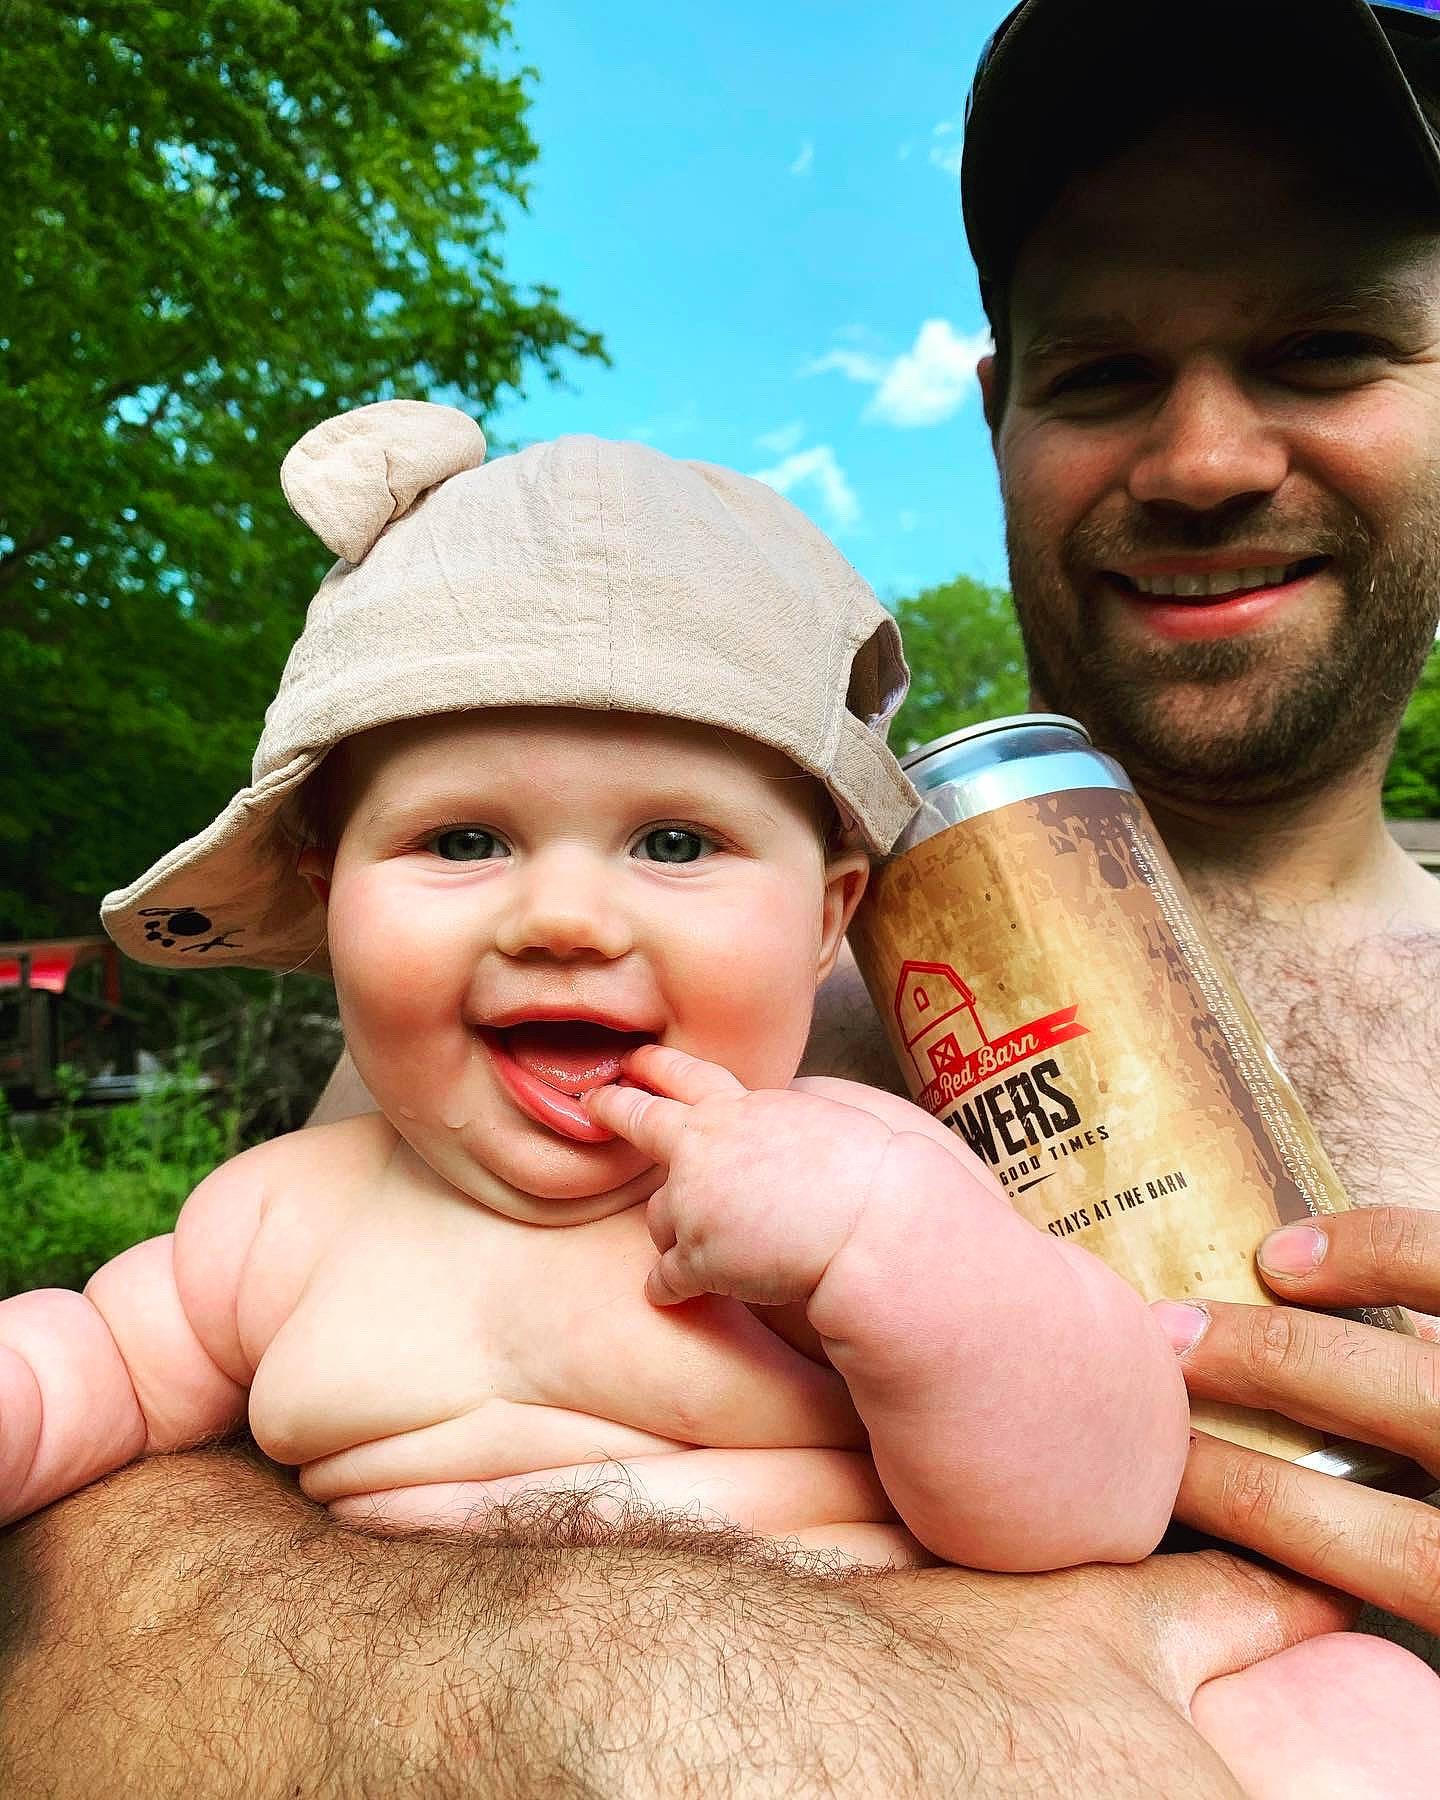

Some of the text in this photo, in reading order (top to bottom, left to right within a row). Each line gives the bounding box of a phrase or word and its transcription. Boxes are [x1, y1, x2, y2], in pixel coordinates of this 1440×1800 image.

[1129, 845, 1148, 872] drink
[1142, 871, 1157, 891] not
[1151, 890, 1174, 926] should
[1171, 927, 1194, 965] women
[1213, 1012, 1242, 1060] Surgeon
[939, 1060, 975, 1098] Red
[978, 1033, 1039, 1076] Barn
[1236, 1060, 1251, 1080] the
[1247, 1081, 1258, 1094] to
[941, 1058, 1081, 1165] WERS
[1253, 1095, 1290, 1156] According
[1000, 1126, 1109, 1185] GOOD TIMES
[1048, 1171, 1188, 1238] STAYS AT THE BARN
[1292, 1174, 1319, 1217] RNING:
